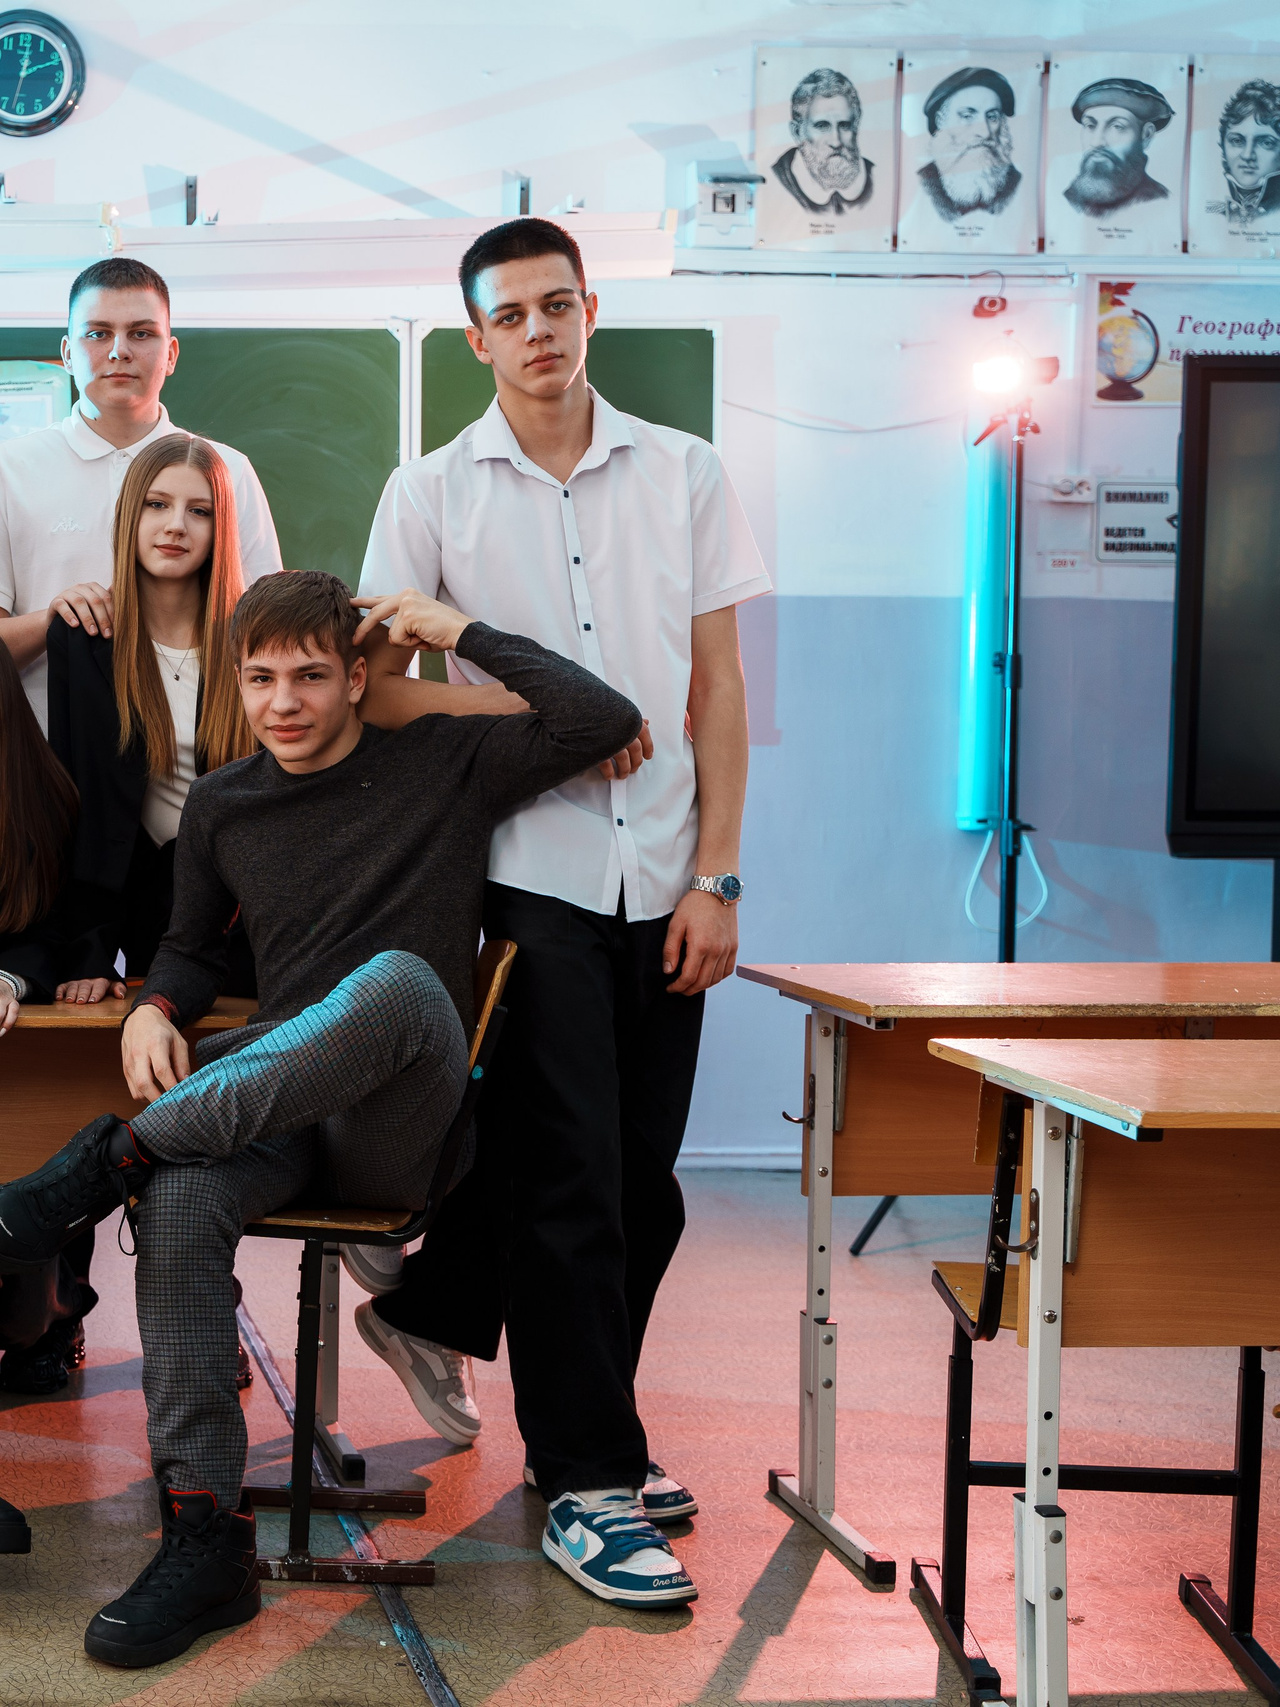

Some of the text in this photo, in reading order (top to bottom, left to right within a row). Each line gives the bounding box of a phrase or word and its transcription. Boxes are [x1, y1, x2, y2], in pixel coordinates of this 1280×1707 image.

[3, 37, 14, 51] 11
[19, 33, 32, 47] 12
[40, 39, 45, 52] 1
[54, 70, 64, 84] 3
[47, 87, 55, 100] 4
[1, 96, 10, 109] 7
[16, 102, 25, 115] 6
[33, 99, 43, 112] 5
[1176, 314, 1280, 341] Географ
[652, 1578, 671, 1588] One
